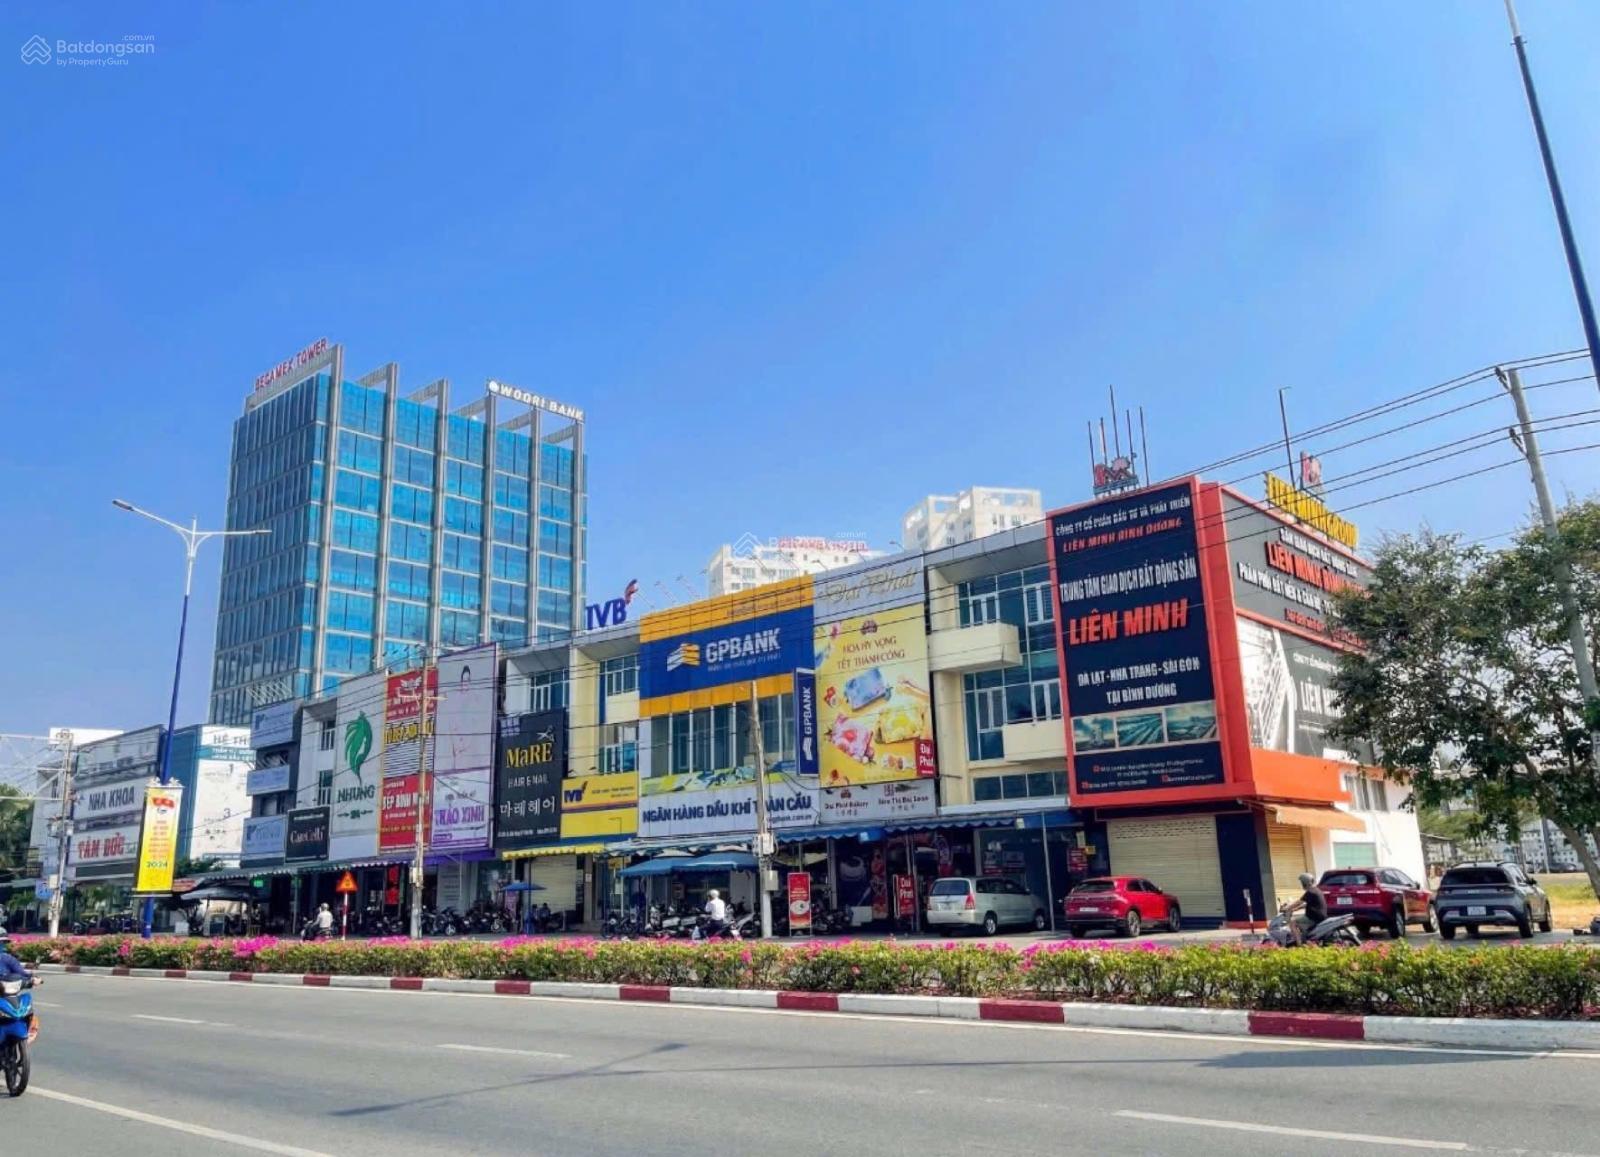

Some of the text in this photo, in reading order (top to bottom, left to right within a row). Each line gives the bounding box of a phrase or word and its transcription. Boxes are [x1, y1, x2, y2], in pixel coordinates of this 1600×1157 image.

[296, 337, 328, 365] TOWER
[501, 384, 584, 421] WOORI BANK
[1101, 573, 1119, 595] GIAO
[1069, 598, 1188, 645] LIÊN MINH
[705, 627, 781, 663] GPBANK
[1129, 662, 1157, 679] TRANG
[802, 686, 813, 735] GPBANK
[506, 742, 553, 769] MaRE
[109, 786, 135, 808] KHOA
[642, 806, 672, 823] NGÂN
[673, 802, 704, 821] HÀNG
[706, 799, 729, 818] DẦU
[731, 797, 751, 815] KHÍ
[786, 791, 811, 811] CẦU
